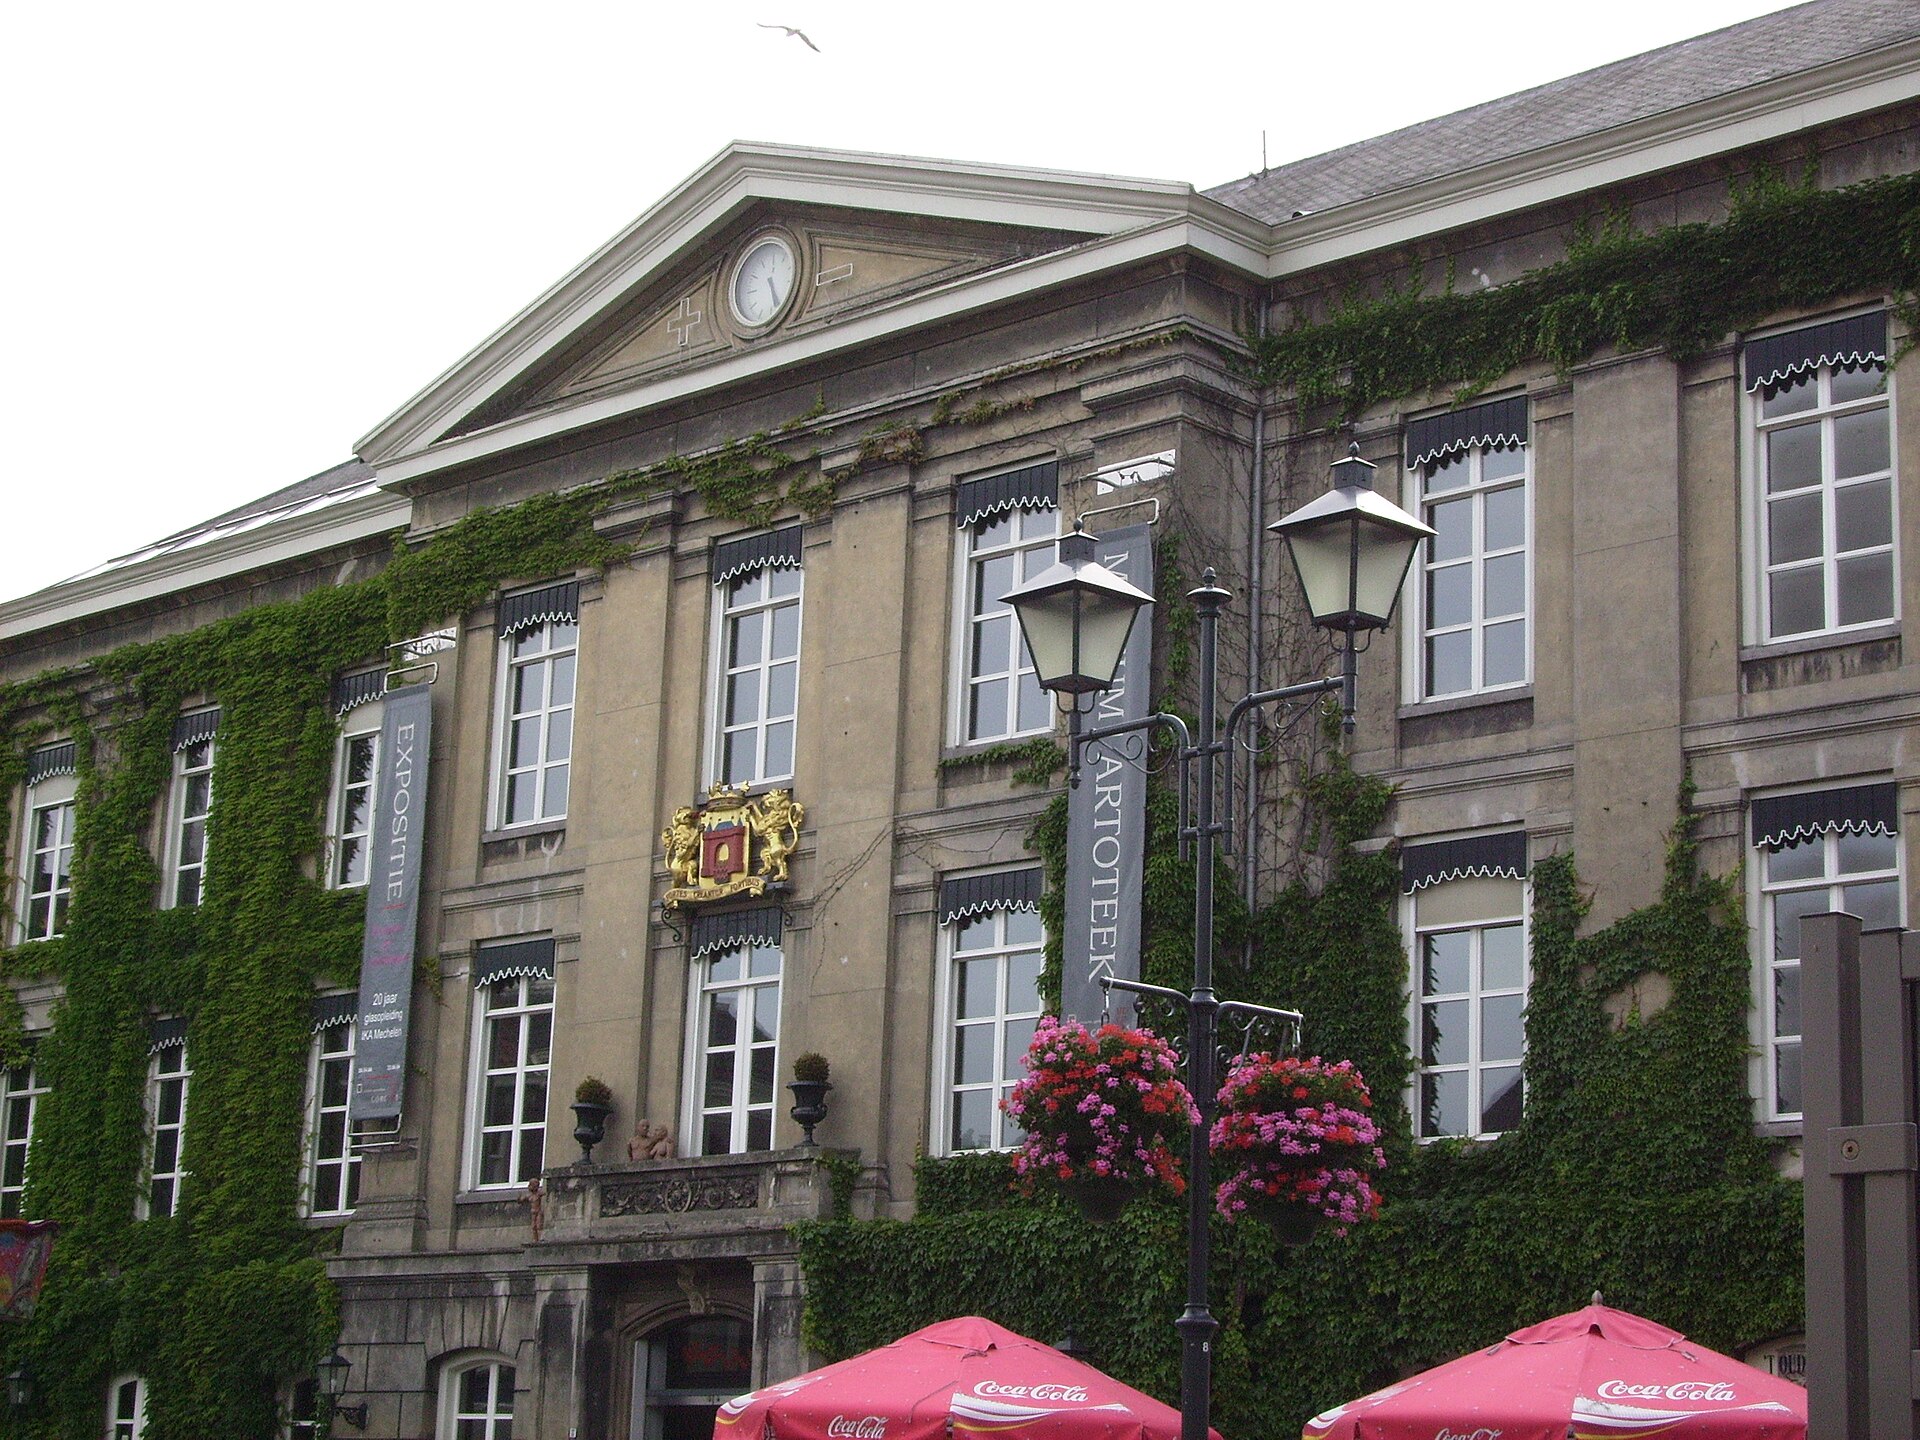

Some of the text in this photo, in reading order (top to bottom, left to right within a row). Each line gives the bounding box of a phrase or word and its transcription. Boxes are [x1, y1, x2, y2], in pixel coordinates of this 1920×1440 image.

[387, 722, 415, 901] EXPOSITIE
[1088, 752, 1123, 985] ARTOTEEK
[372, 992, 398, 1007] 20 jaar
[364, 1010, 403, 1026] glasopleiding
[361, 1027, 402, 1041] IKA Mechelen
[1202, 1341, 1209, 1353] 8
[973, 1380, 1088, 1402] Coca-Cola
[1597, 1379, 1736, 1401] Coca-Cola
[828, 1414, 889, 1439] Coca-Cola
